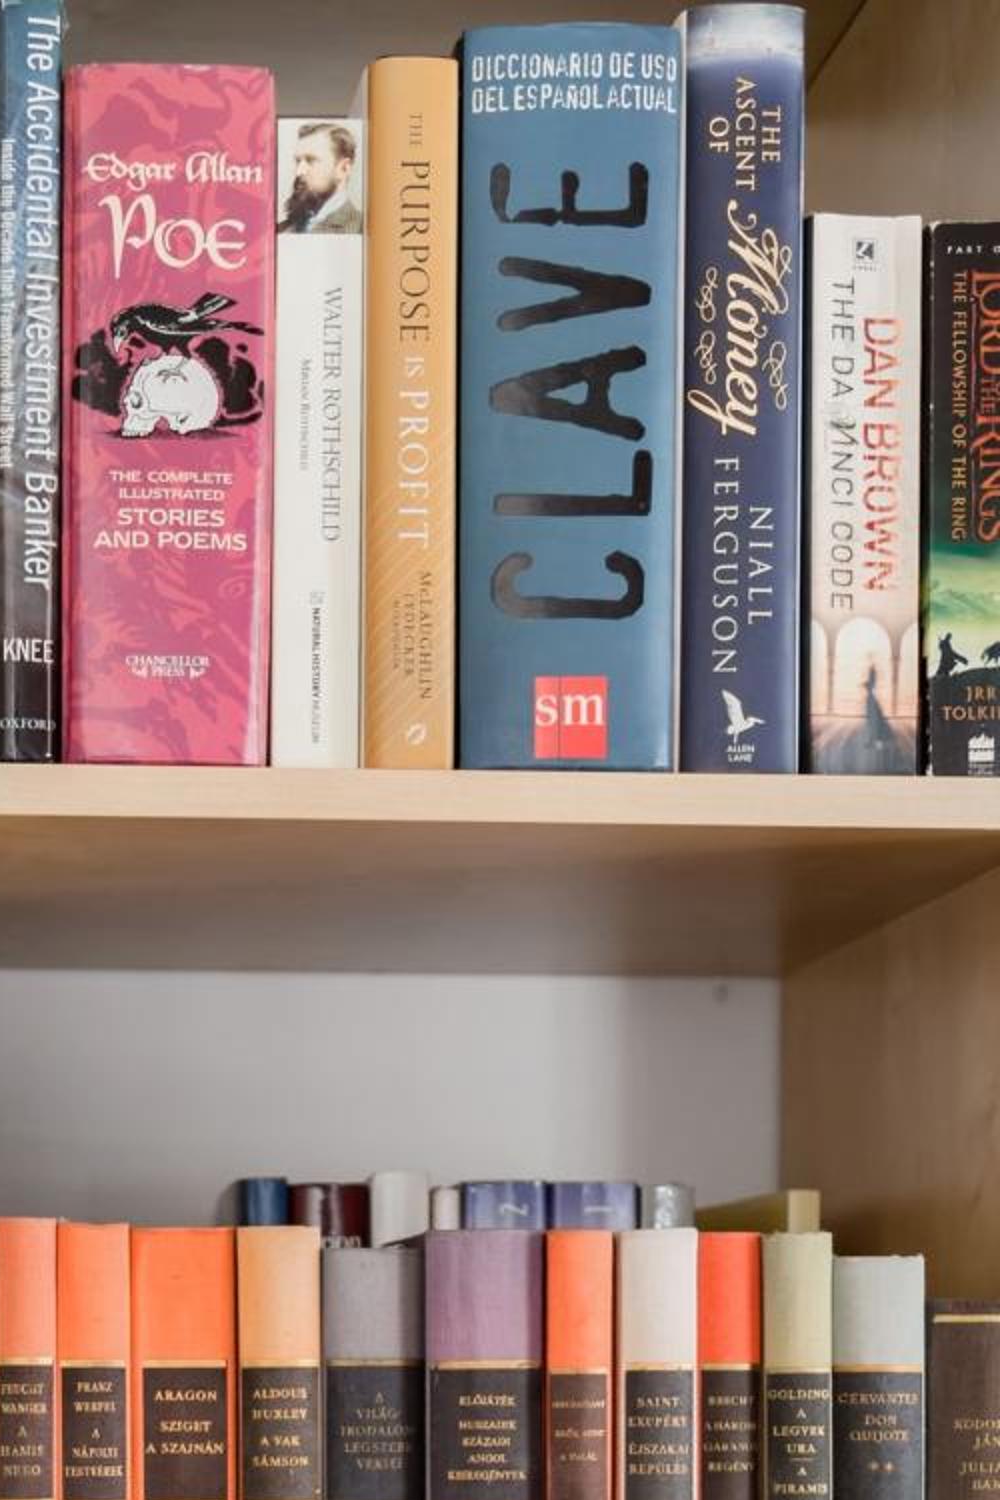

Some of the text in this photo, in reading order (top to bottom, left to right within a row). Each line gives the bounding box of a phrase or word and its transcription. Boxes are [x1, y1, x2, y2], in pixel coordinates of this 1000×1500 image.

[472, 52, 677, 82] DICCIONARIO DE USO
[472, 83, 677, 114] DEL ESPAÑOL ACTUAL
[709, 117, 730, 153] OF
[735, 77, 758, 191] ASCENT
[761, 105, 782, 163] THE
[82, 151, 262, 191] Edgar Allan
[98, 194, 247, 279] POE
[23, 15, 60, 590] The Accidental Investment Banker
[688, 199, 793, 436] Money
[398, 114, 431, 549] THE PURPOSE IS PROFIT
[489, 161, 653, 620] CLAVE
[321, 287, 342, 543] WALTER ROTHSCHILD
[952, 271, 967, 540] THE FELLOWSHIP OF THE RING
[831, 277, 859, 610] THE DA VINCI CODE
[863, 317, 901, 591] DAN BROWN
[109, 470, 232, 484] THE COMPLETE
[119, 487, 225, 500] ILLUSTRATED
[117, 508, 225, 527] STORIES
[94, 531, 247, 551] AND POEMS
[712, 456, 740, 673] FERGUSON
[747, 507, 774, 625] NIALL
[3, 637, 54, 663] KNEE
[126, 655, 209, 667] CHANCELLOR
[535, 692, 606, 728] sm
[0, 717, 56, 730] OXFORD
[155, 1390, 217, 1401] ARAGON
[253, 1388, 307, 1399] ALDOUS
[637, 1397, 680, 1407] SAINT
[768, 1389, 829, 1400] GOLDING
[838, 1392, 919, 1404] CERVANTES
[252, 1409, 308, 1420] HUXLEY
[796, 1408, 806, 1418] A
[865, 1414, 897, 1425] DON
[18, 1426, 27, 1437] A
[91, 1428, 100, 1439] A
[160, 1421, 212, 1433] SZIGET
[146, 1441, 224, 1454] A SZAJNÁN
[261, 1437, 270, 1447] A
[787, 1443, 816, 1453] URA
[797, 1466, 807, 1476] A
